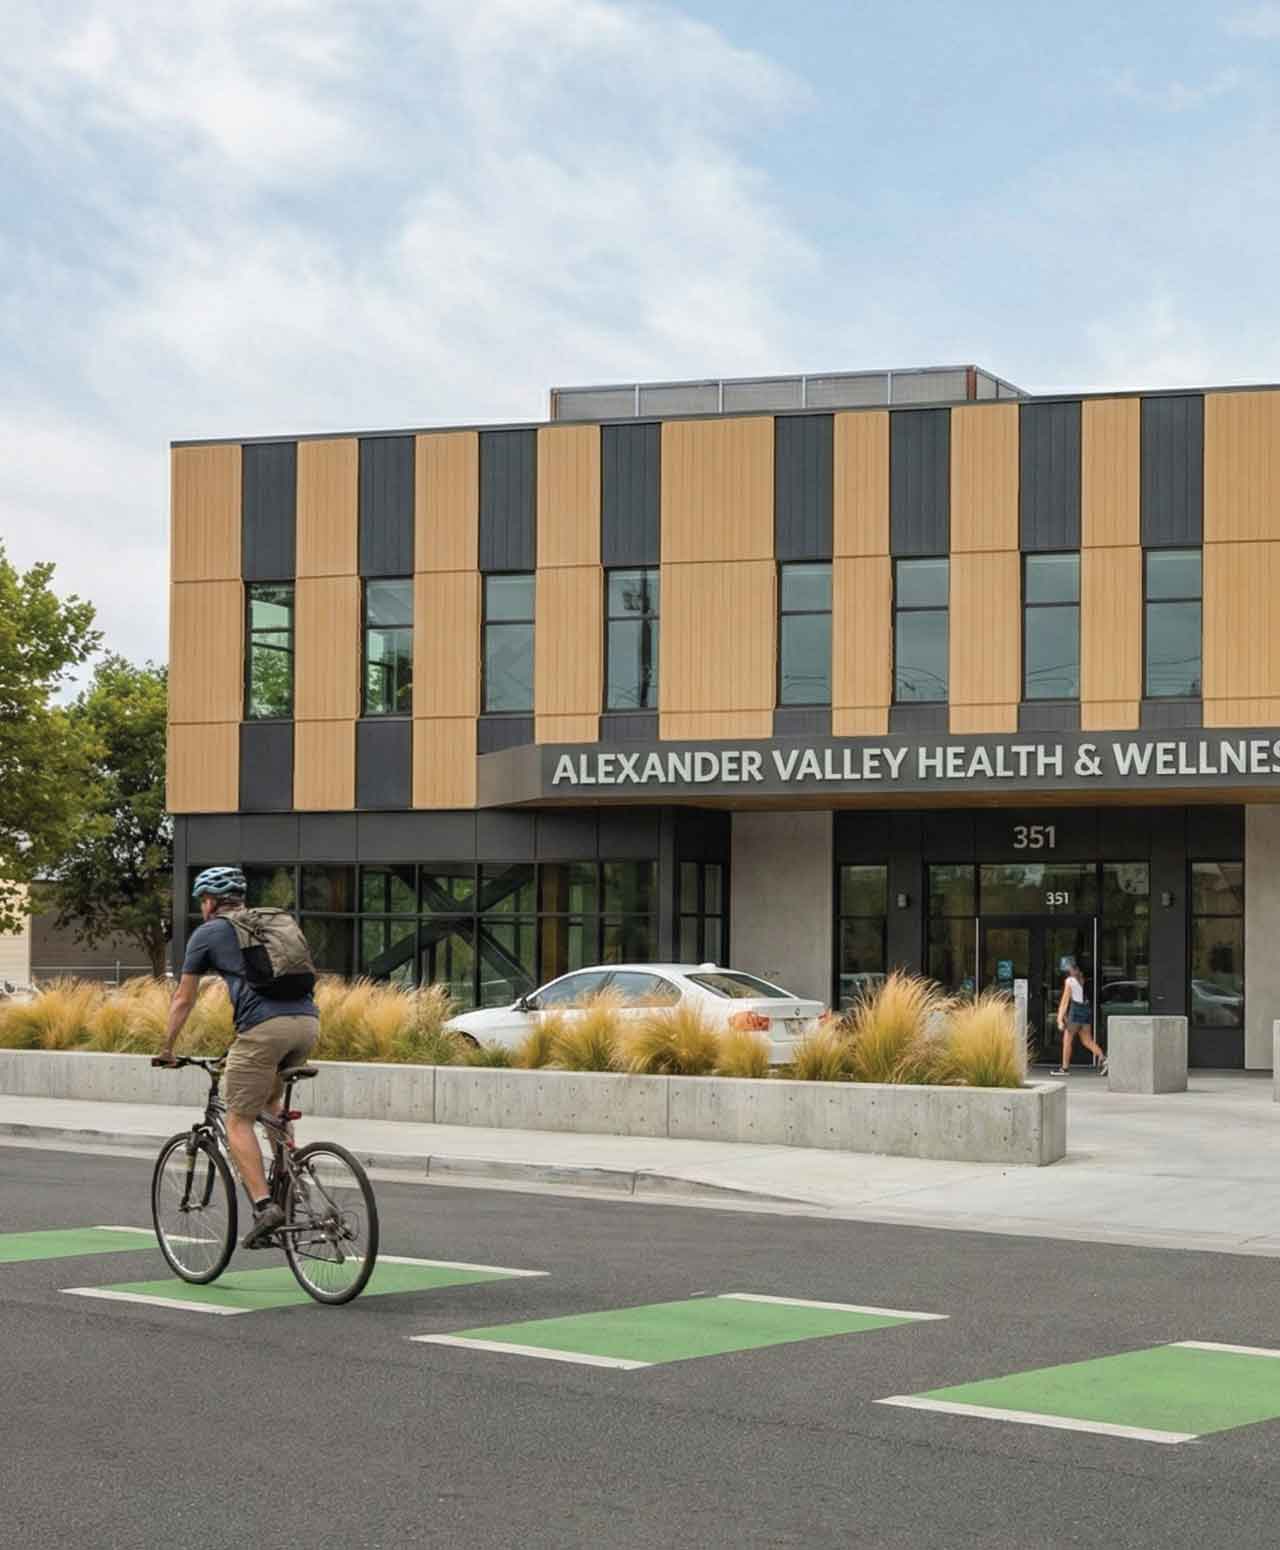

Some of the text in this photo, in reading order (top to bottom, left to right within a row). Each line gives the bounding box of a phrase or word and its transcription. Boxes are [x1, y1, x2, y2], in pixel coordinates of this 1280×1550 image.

[552, 752, 763, 785] ALEXANDER
[773, 747, 908, 780] VALLEY
[919, 744, 1063, 777] HEALTH
[1074, 743, 1103, 776] &
[1013, 825, 1055, 848] 351
[1046, 892, 1069, 904] 351
